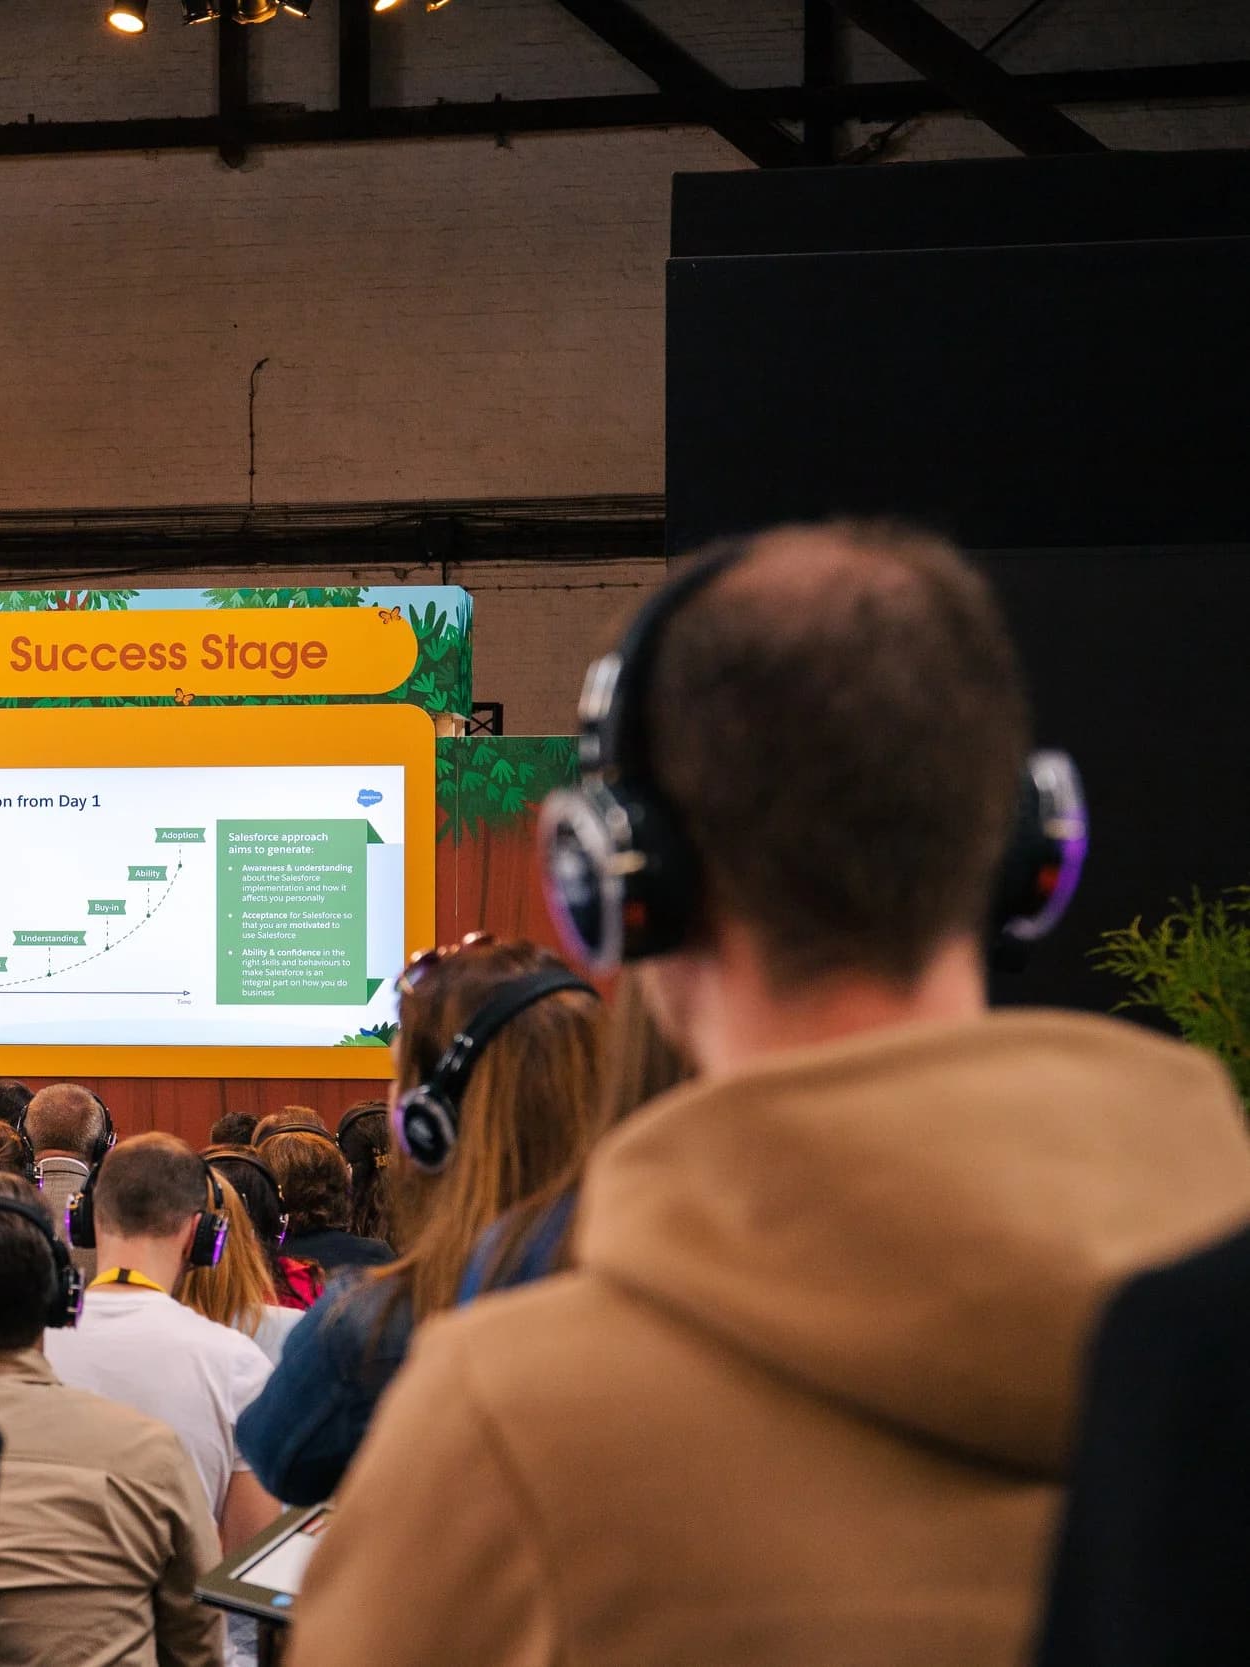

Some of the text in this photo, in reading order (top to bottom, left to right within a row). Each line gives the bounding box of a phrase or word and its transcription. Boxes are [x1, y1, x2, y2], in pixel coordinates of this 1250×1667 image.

[9, 633, 328, 679] Success Stage
[17, 795, 53, 808] from
[59, 795, 87, 811] Day
[92, 795, 101, 807] 1
[162, 832, 198, 840] Adoption
[229, 833, 328, 843] Salesforce approach
[229, 845, 314, 856] aims to generate:
[286, 864, 292, 872] &
[295, 864, 353, 873] understanding
[135, 870, 160, 878] Ability
[242, 884, 303, 894] implementation
[305, 884, 320, 892] and
[242, 894, 268, 902] affects
[286, 894, 325, 903] personally
[95, 904, 119, 912] Buy-in
[242, 912, 287, 921] Acceptance
[260, 923, 274, 931] you
[21, 935, 79, 943] Understanding
[242, 949, 267, 958] Ability
[242, 959, 260, 968] right
[242, 979, 270, 988] integral
[273, 980, 288, 988] part
[303, 979, 319, 987] how
[321, 980, 334, 988] you
